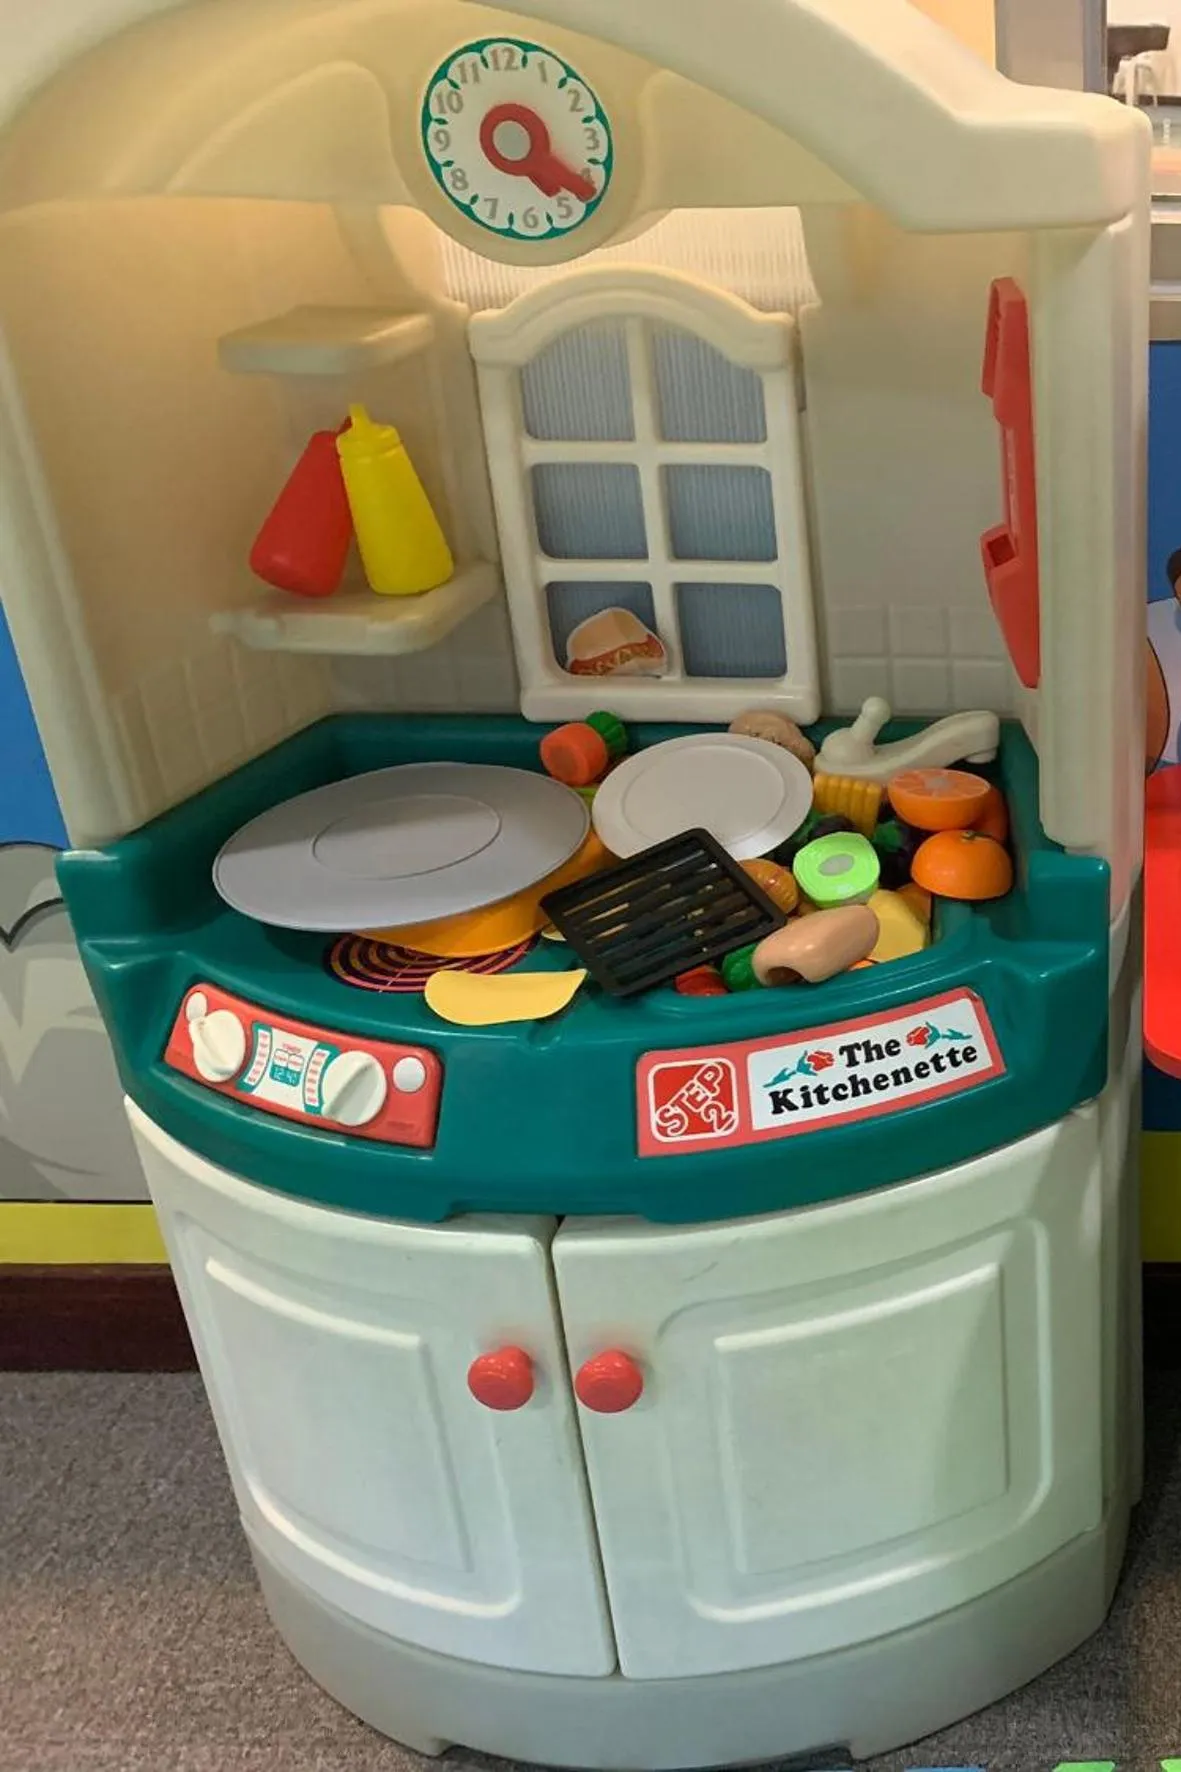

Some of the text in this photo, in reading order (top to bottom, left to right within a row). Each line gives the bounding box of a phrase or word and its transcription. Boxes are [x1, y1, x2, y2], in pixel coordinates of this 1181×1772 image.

[490, 46, 520, 72] 12
[457, 61, 481, 85] 11
[537, 59, 548, 84] 1
[435, 89, 464, 114] 10
[567, 89, 585, 113] 2
[433, 128, 451, 152] 9
[584, 127, 600, 151] 3
[450, 167, 469, 191] 8
[483, 197, 499, 220] 7
[522, 206, 539, 229] 6
[556, 196, 573, 219] 5
[838, 1037, 902, 1069] The
[768, 1044, 979, 1116] Kitchenette
[656, 1062, 724, 1137] STEP
[700, 1099, 736, 1135] 2
